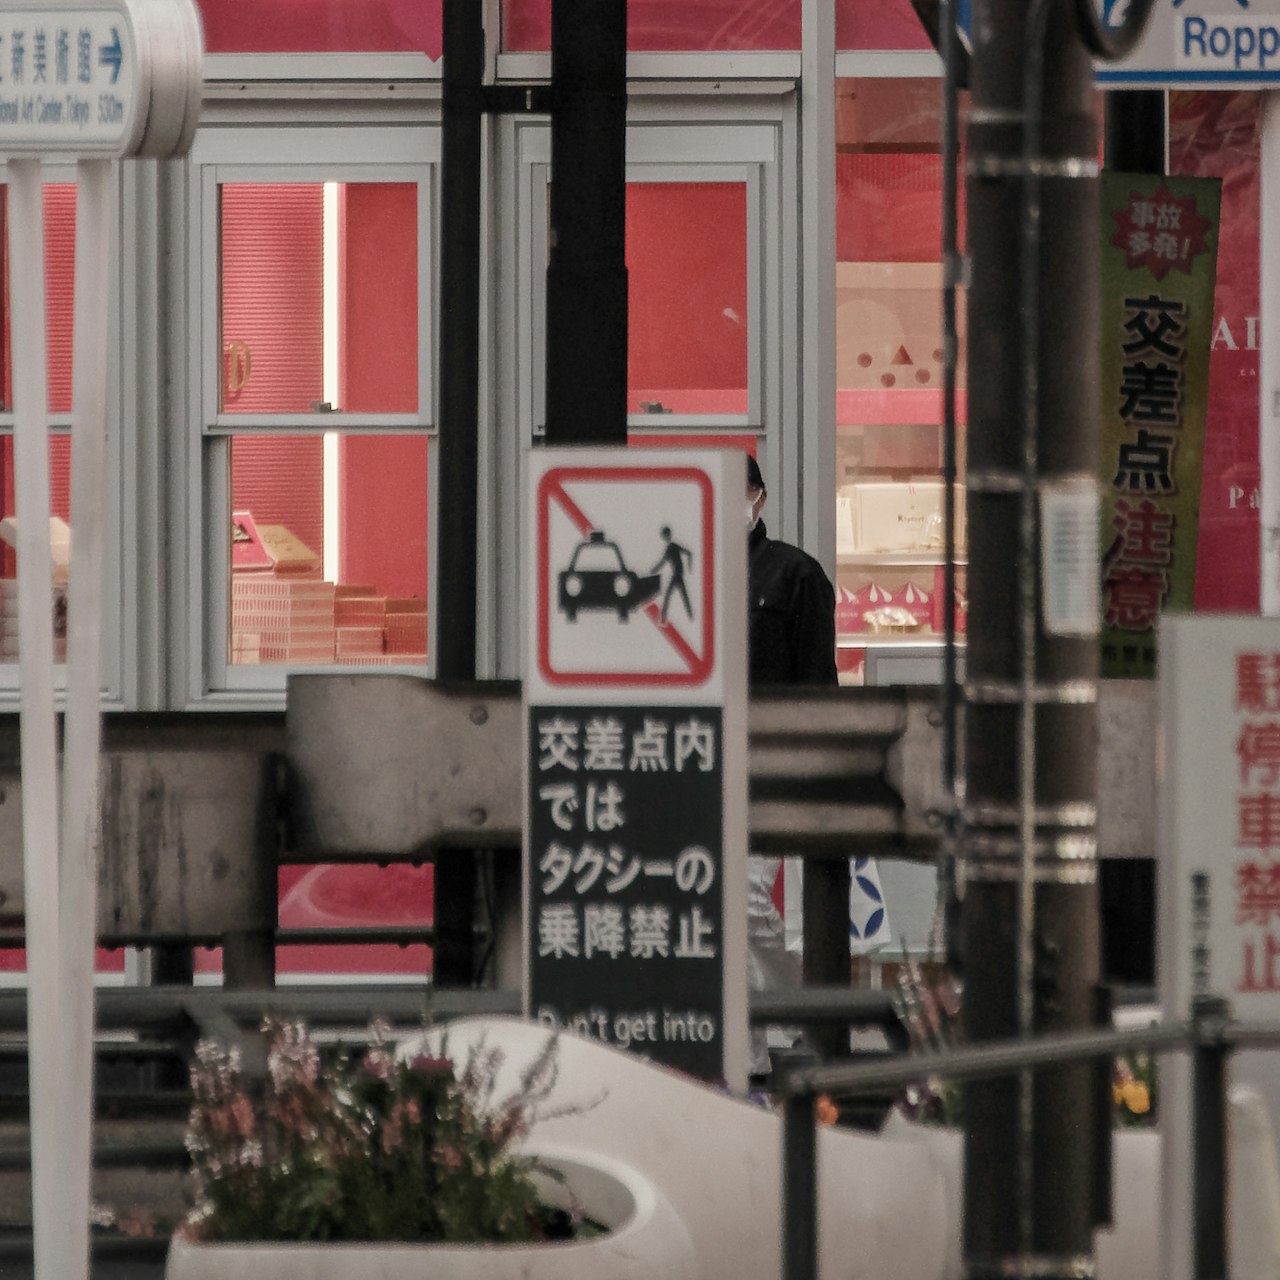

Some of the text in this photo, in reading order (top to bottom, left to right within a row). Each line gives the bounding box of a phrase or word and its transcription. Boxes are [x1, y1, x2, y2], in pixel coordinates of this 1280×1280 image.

[1102, 294, 1187, 631] 交差点注意
[538, 718, 716, 774] 交差点内
[538, 781, 625, 833] では
[539, 843, 715, 897] タクシーの
[538, 905, 717, 960] 乗降禁止
[614, 1010, 656, 1048] get
[662, 1007, 715, 1041] into
